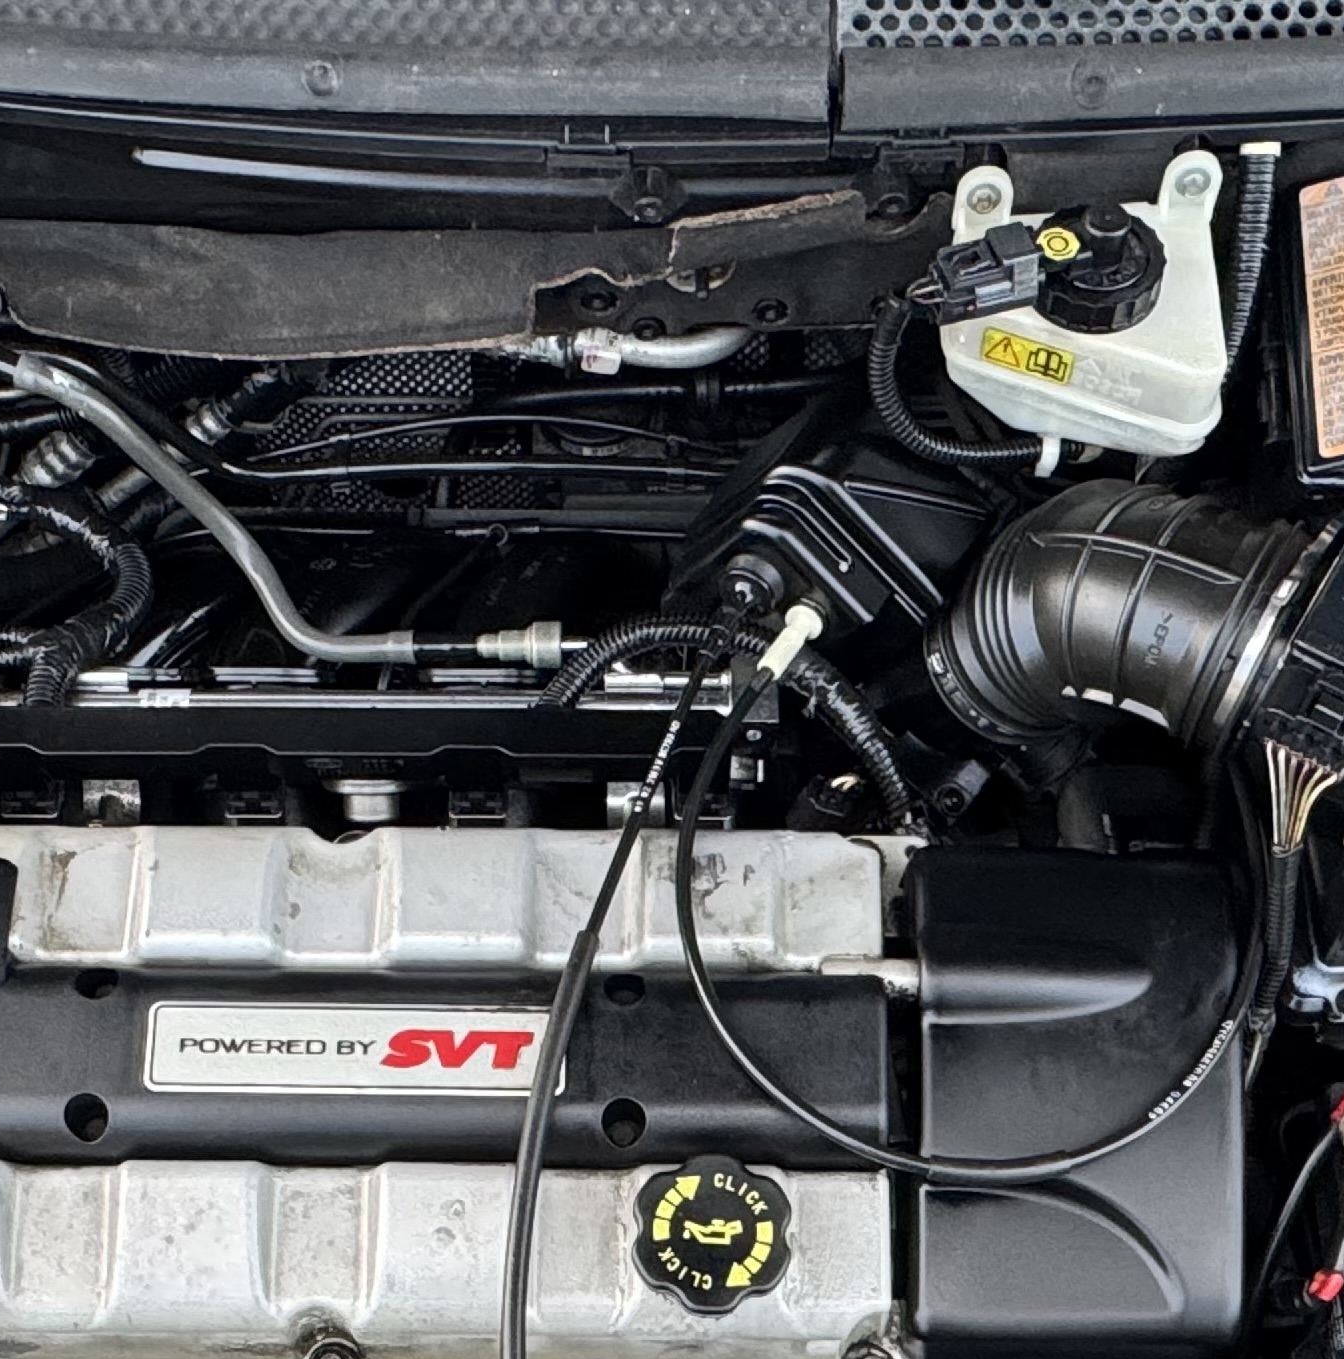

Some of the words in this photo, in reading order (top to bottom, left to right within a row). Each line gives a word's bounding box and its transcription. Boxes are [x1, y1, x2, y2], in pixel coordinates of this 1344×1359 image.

[179, 1038, 327, 1055] POWERED
[336, 1040, 377, 1056] BY
[379, 1029, 535, 1069] SVT
[713, 1173, 768, 1216] CLICK
[658, 1247, 712, 1290] CLICK
